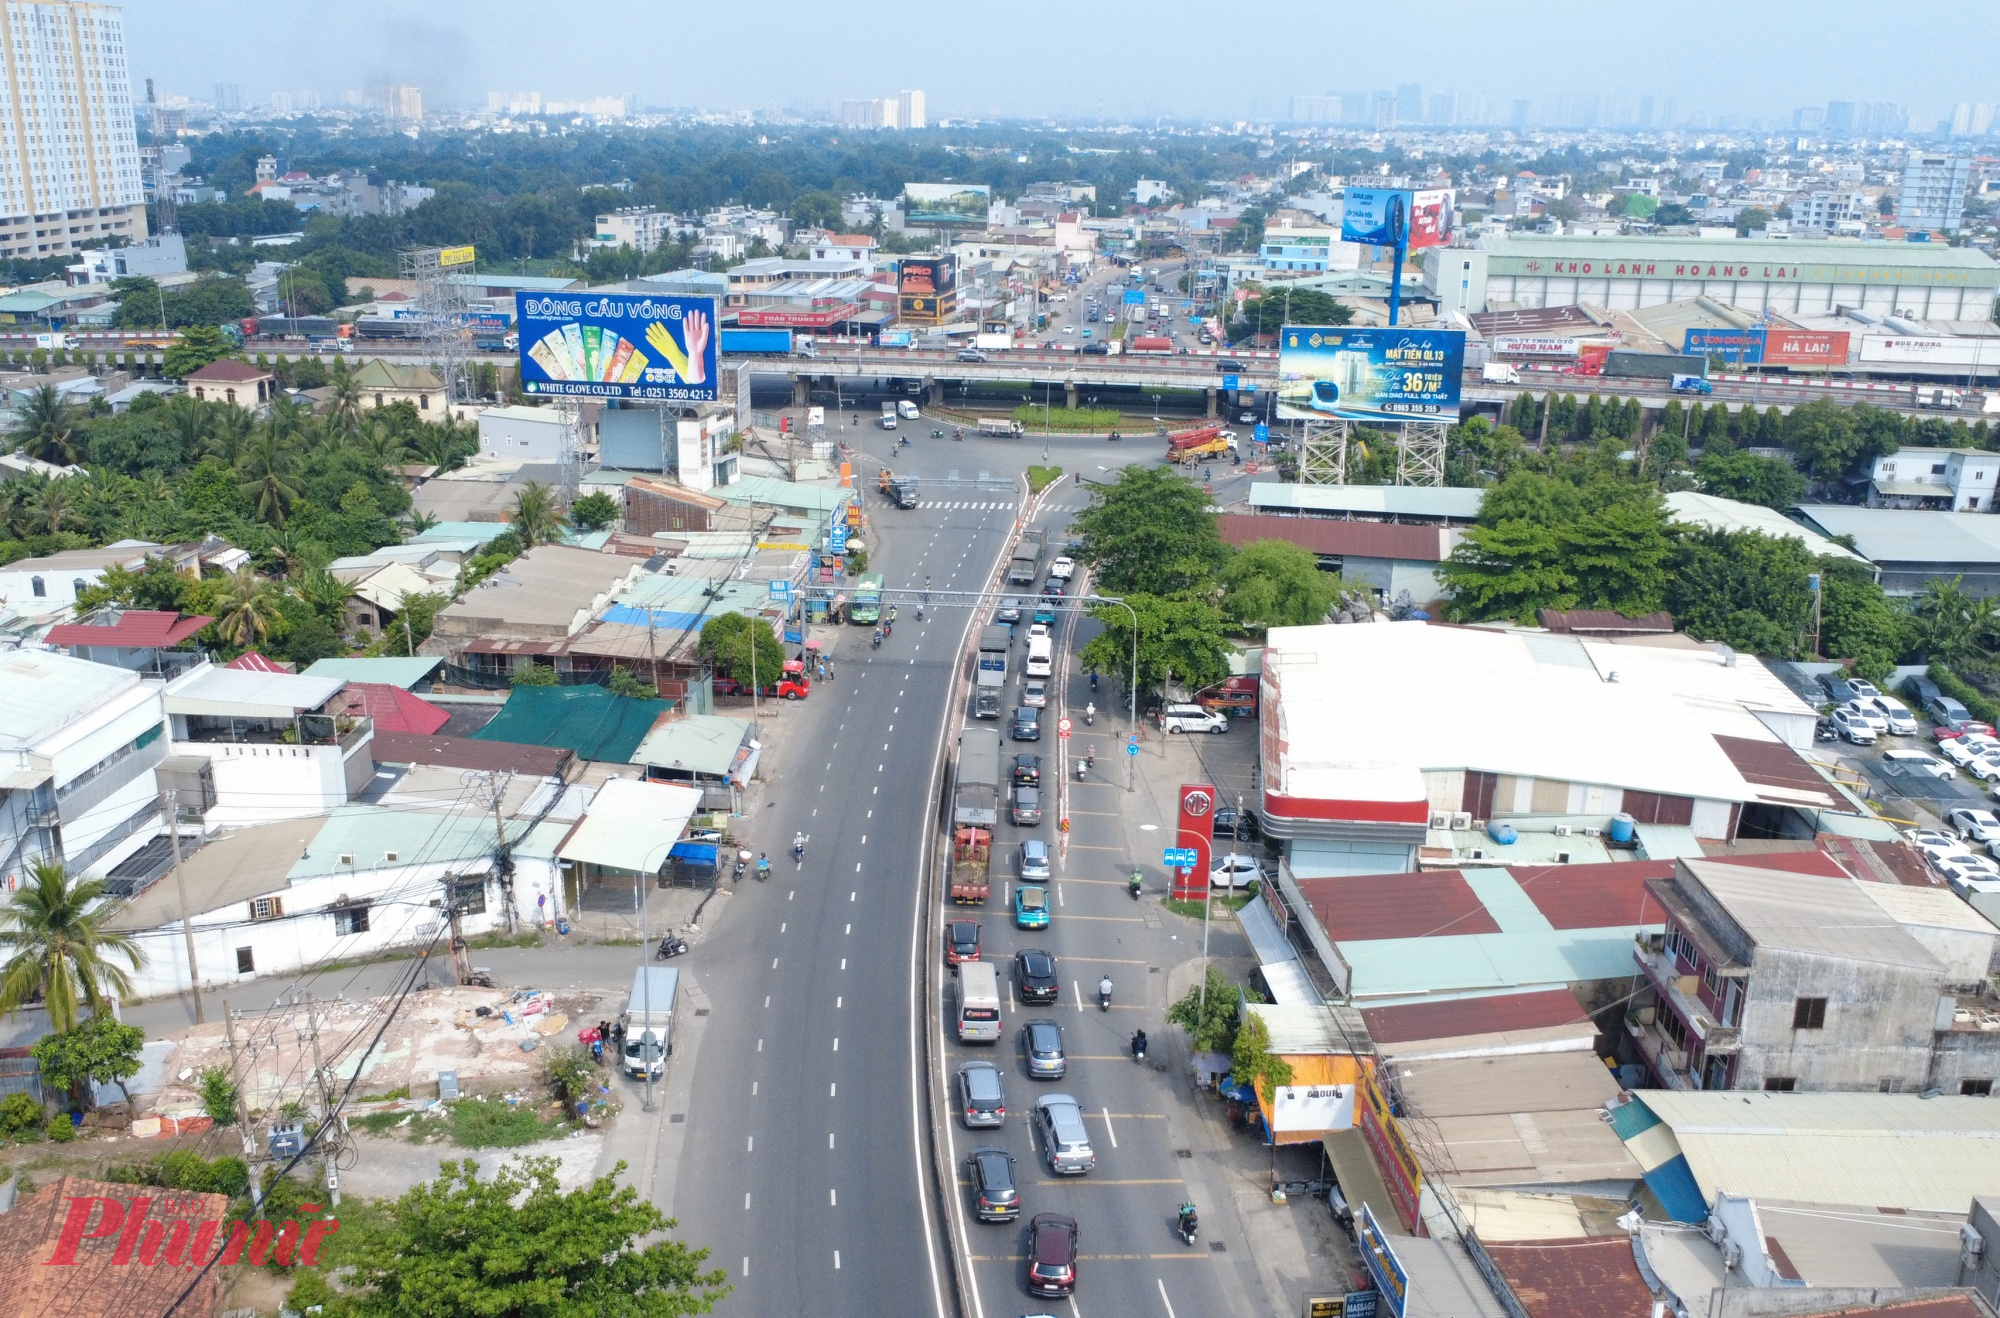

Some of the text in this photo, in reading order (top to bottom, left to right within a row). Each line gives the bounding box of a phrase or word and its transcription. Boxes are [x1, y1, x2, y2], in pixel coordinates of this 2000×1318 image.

[1554, 263, 1592, 273] KHO
[1764, 268, 1797, 278] LAI
[1783, 340, 1830, 352] HÀ LAN
[1402, 372, 1423, 392] 36
[1424, 373, 1443, 381] TRIỆU
[539, 383, 564, 392] WHITE
[566, 384, 591, 394] GLOVE
[646, 388, 665, 398] 0251
[668, 388, 688, 398] 3560
[690, 389, 712, 400] 421-2
[1186, 793, 1209, 815] MG
[1347, 1301, 1376, 1313] MASSAGE
